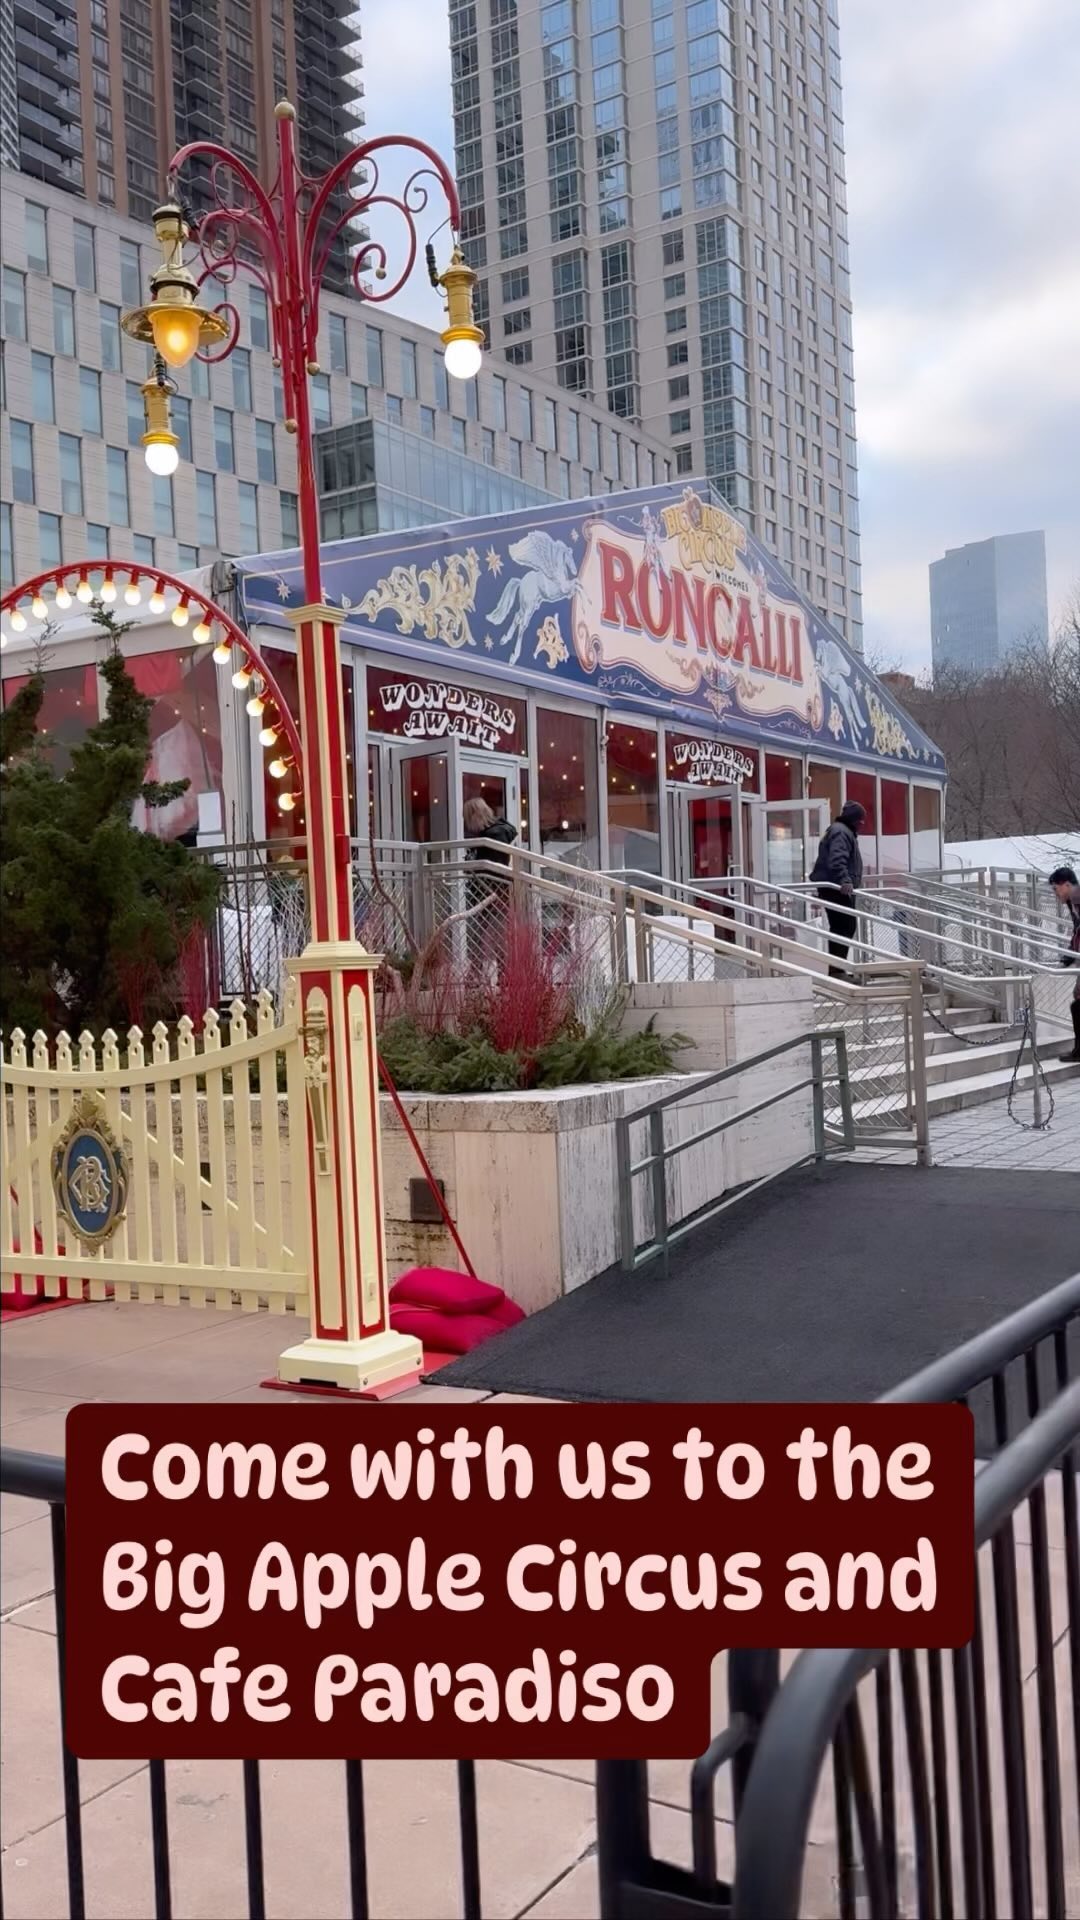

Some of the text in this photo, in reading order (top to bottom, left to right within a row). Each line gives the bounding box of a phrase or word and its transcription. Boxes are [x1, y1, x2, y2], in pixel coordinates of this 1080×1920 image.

[598, 539, 804, 685] RONCALLI
[380, 682, 516, 734] WONDERS
[403, 710, 501, 750] AWAIT
[673, 741, 754, 778] WONDERS
[687, 761, 744, 784] AWAIT
